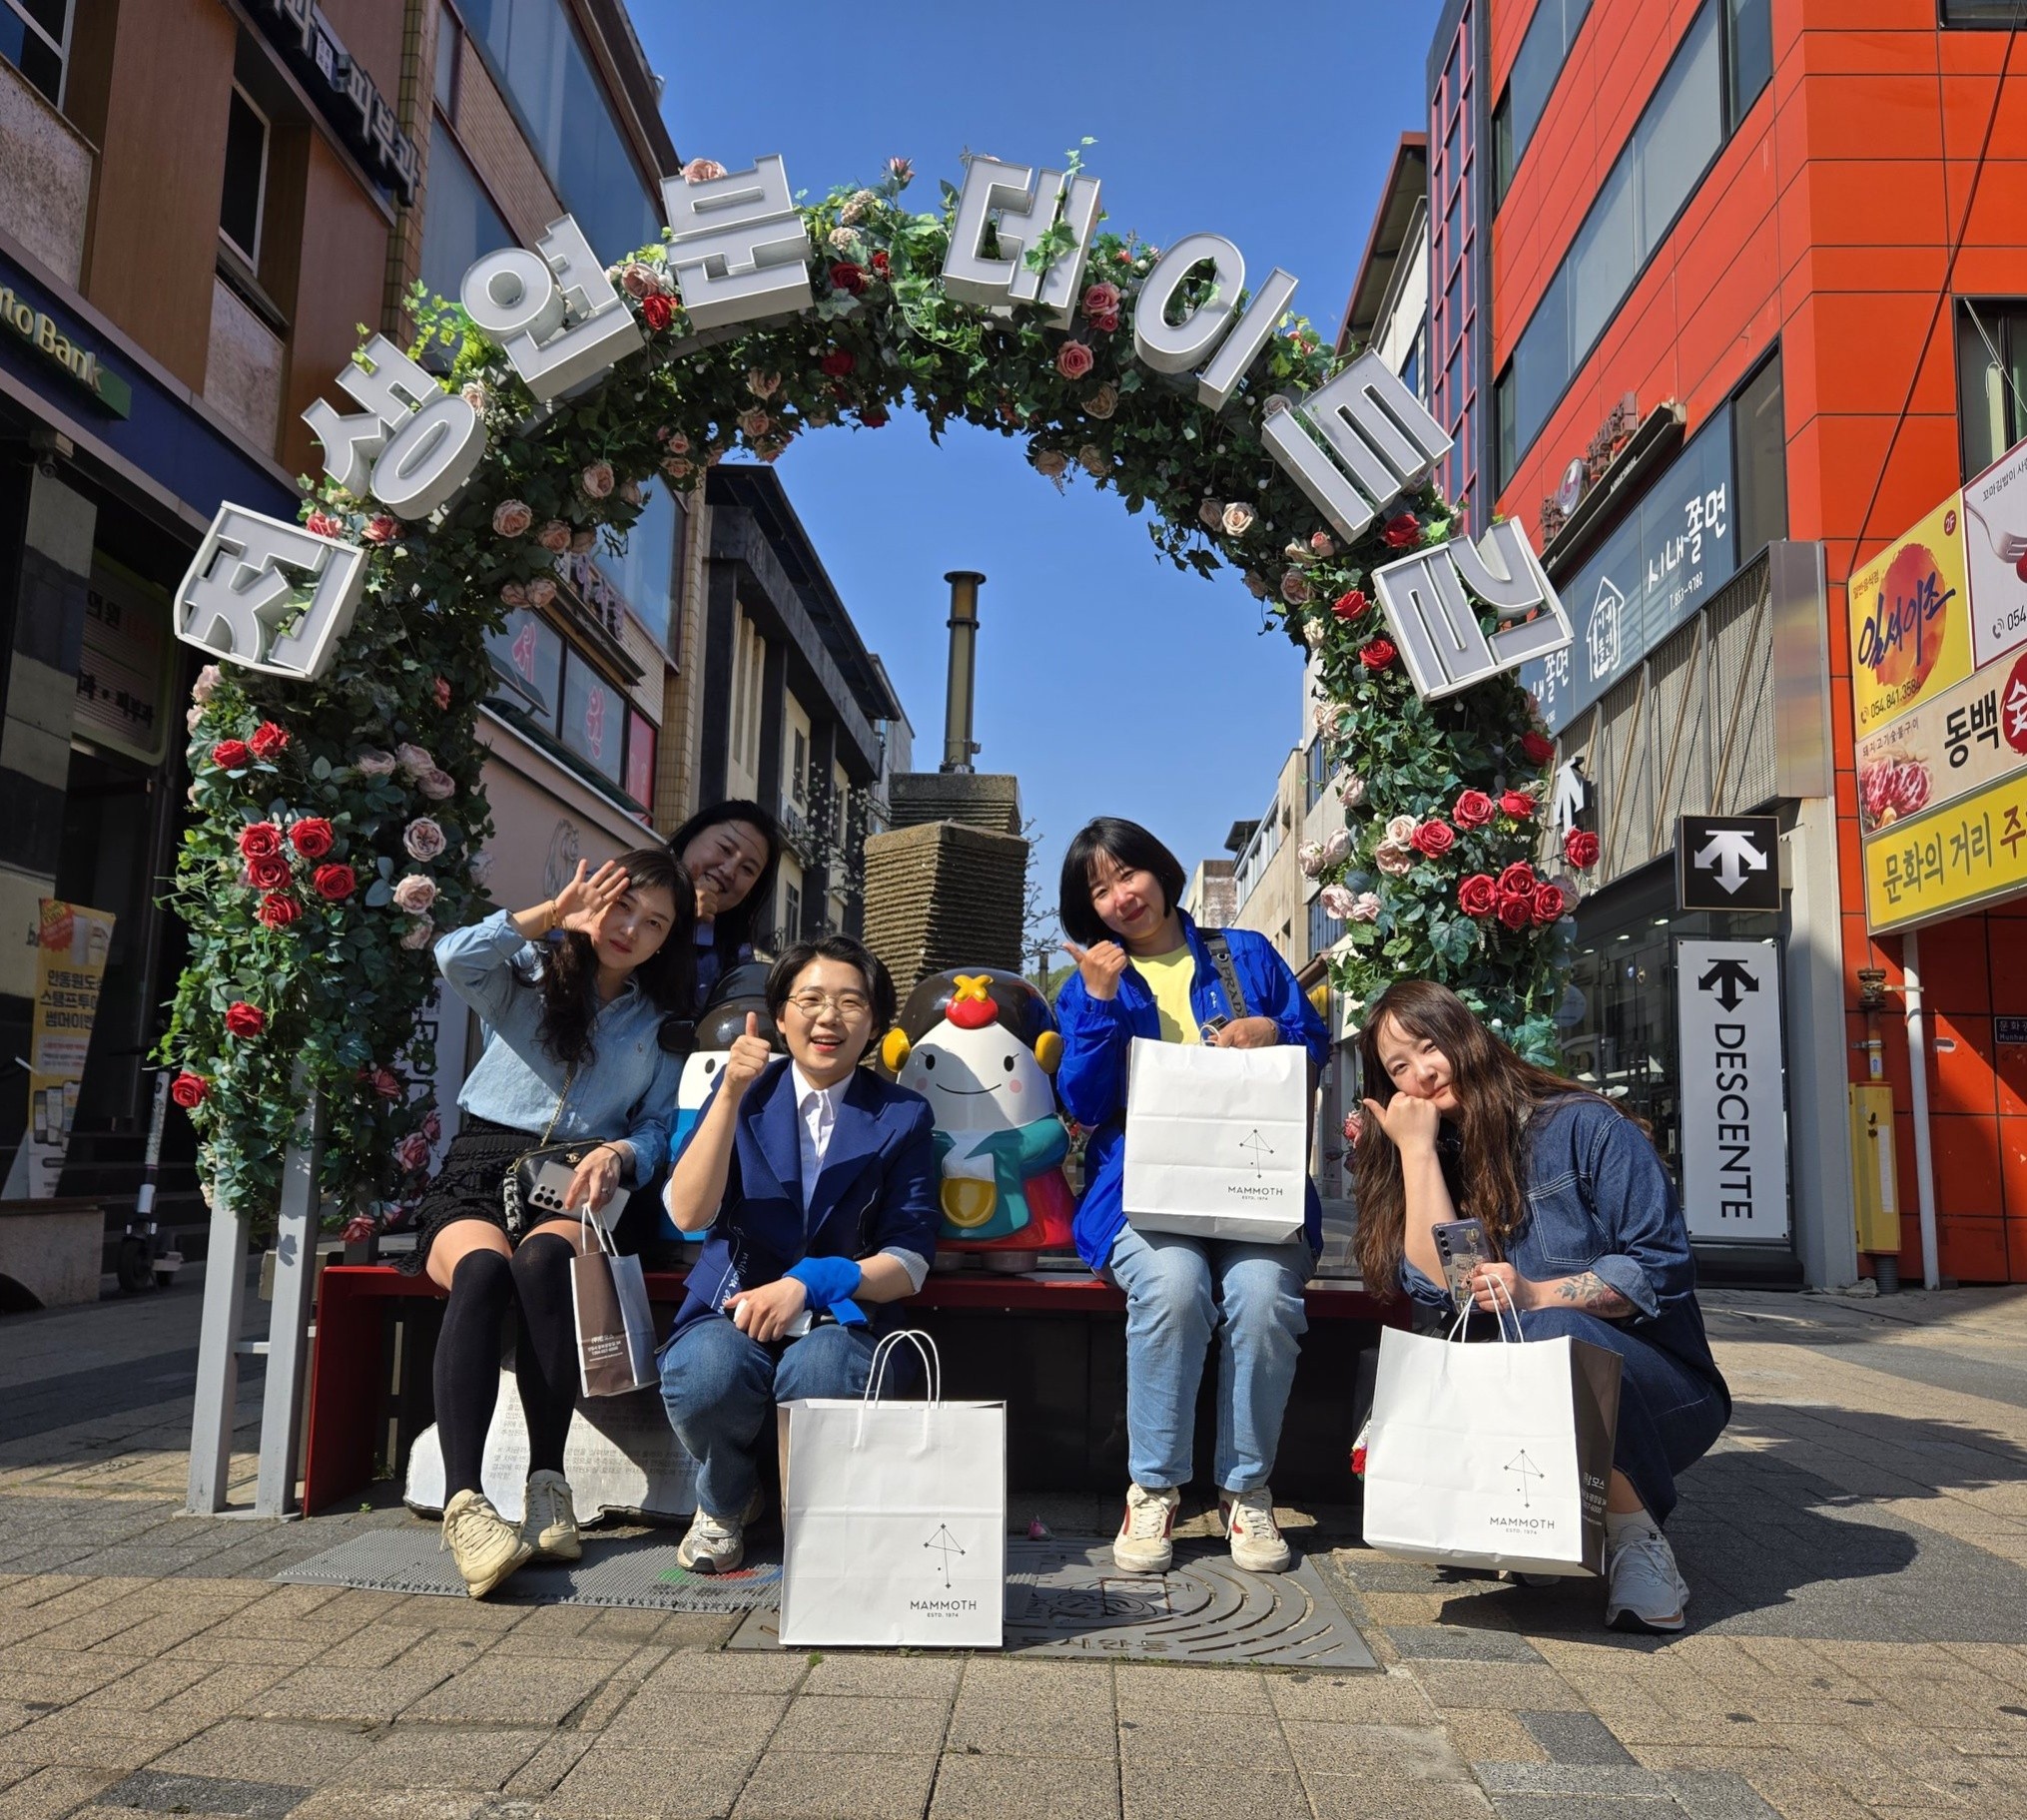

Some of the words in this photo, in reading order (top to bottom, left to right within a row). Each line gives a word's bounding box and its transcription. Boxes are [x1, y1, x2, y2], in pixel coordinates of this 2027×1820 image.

[1945, 514, 1956, 533] 2F
[1870, 678, 1922, 719] 054.841.3584
[1883, 832, 1944, 905] 문화의
[1950, 811, 1993, 877] 거리
[2000, 805, 2027, 860] 주
[1221, 965, 1244, 1018] PRAD
[1713, 1023, 1753, 1220] DESCENTE
[1227, 1186, 1283, 1196] MAMMOTH
[1489, 1517, 1556, 1529] MAMMOTH
[910, 1600, 977, 1610] MAMMOTH
